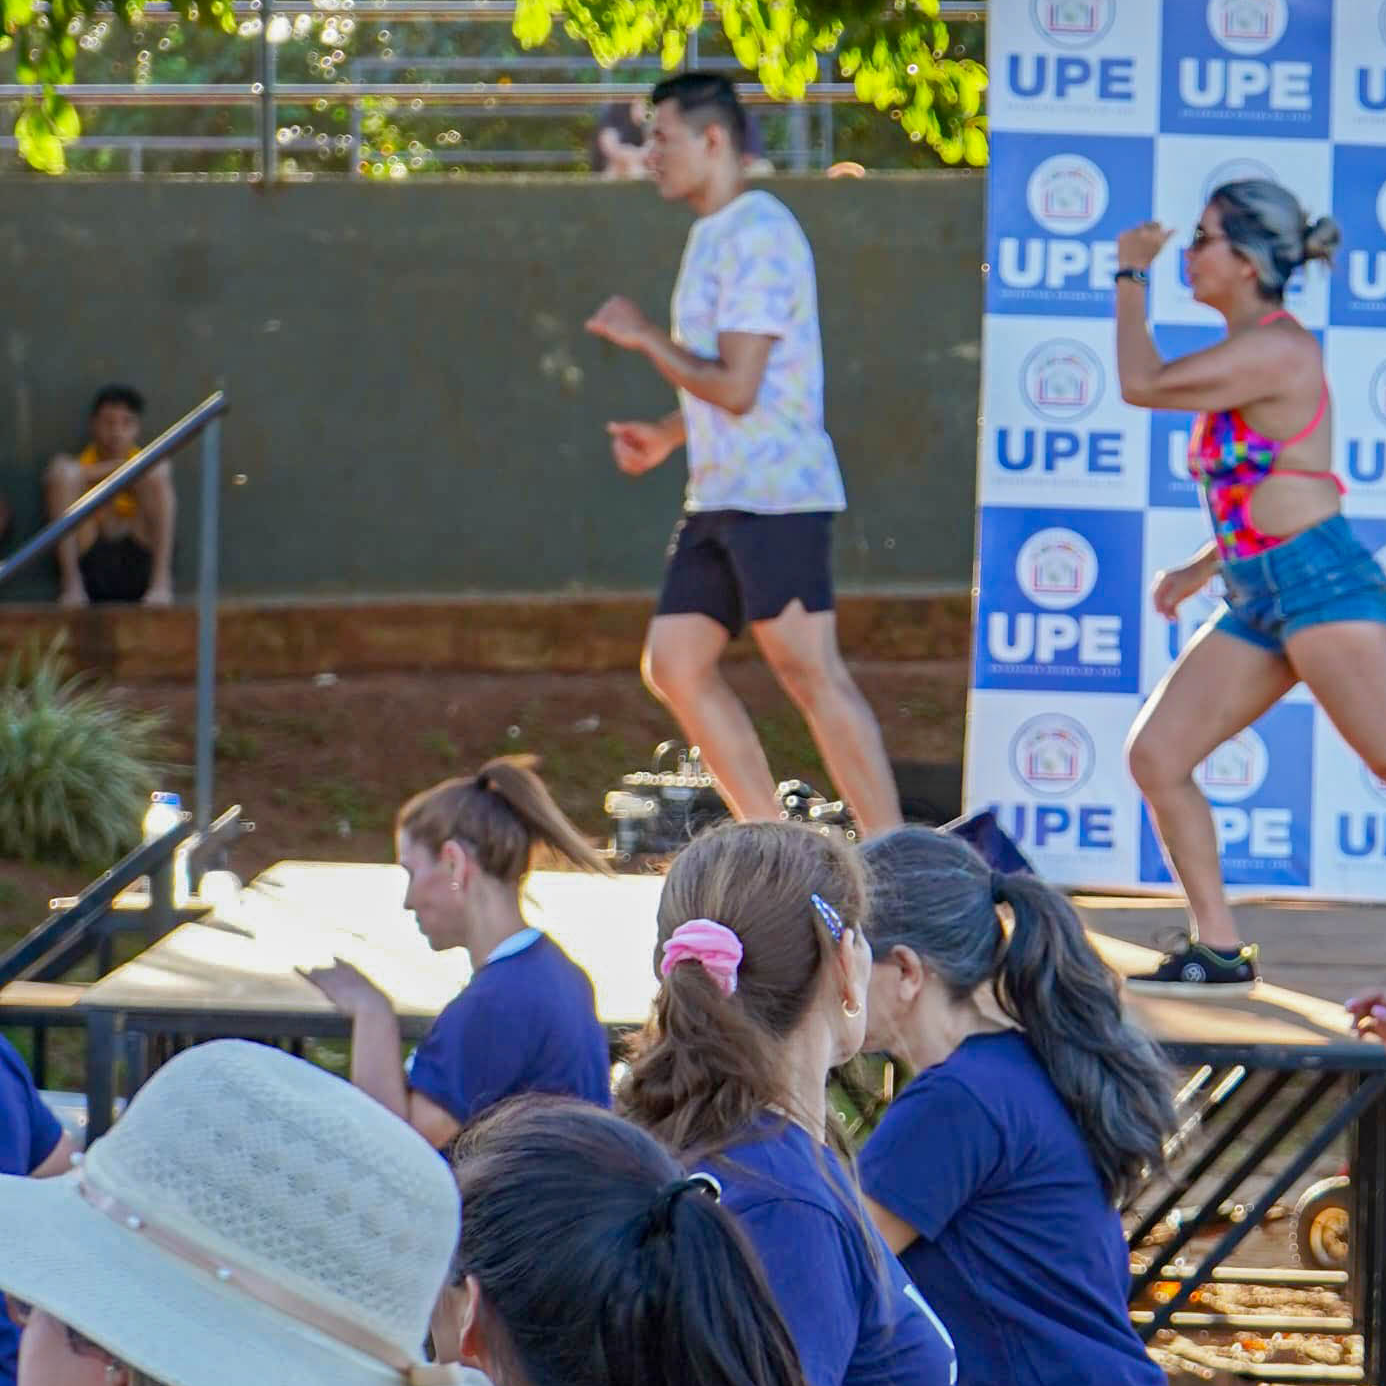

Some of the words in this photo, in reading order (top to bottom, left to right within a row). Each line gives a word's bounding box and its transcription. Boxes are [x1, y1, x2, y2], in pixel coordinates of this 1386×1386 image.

[1007, 54, 1136, 102] UPE
[1178, 57, 1313, 111] UPE
[996, 428, 1125, 475] UPE
[987, 611, 1122, 666] UPE
